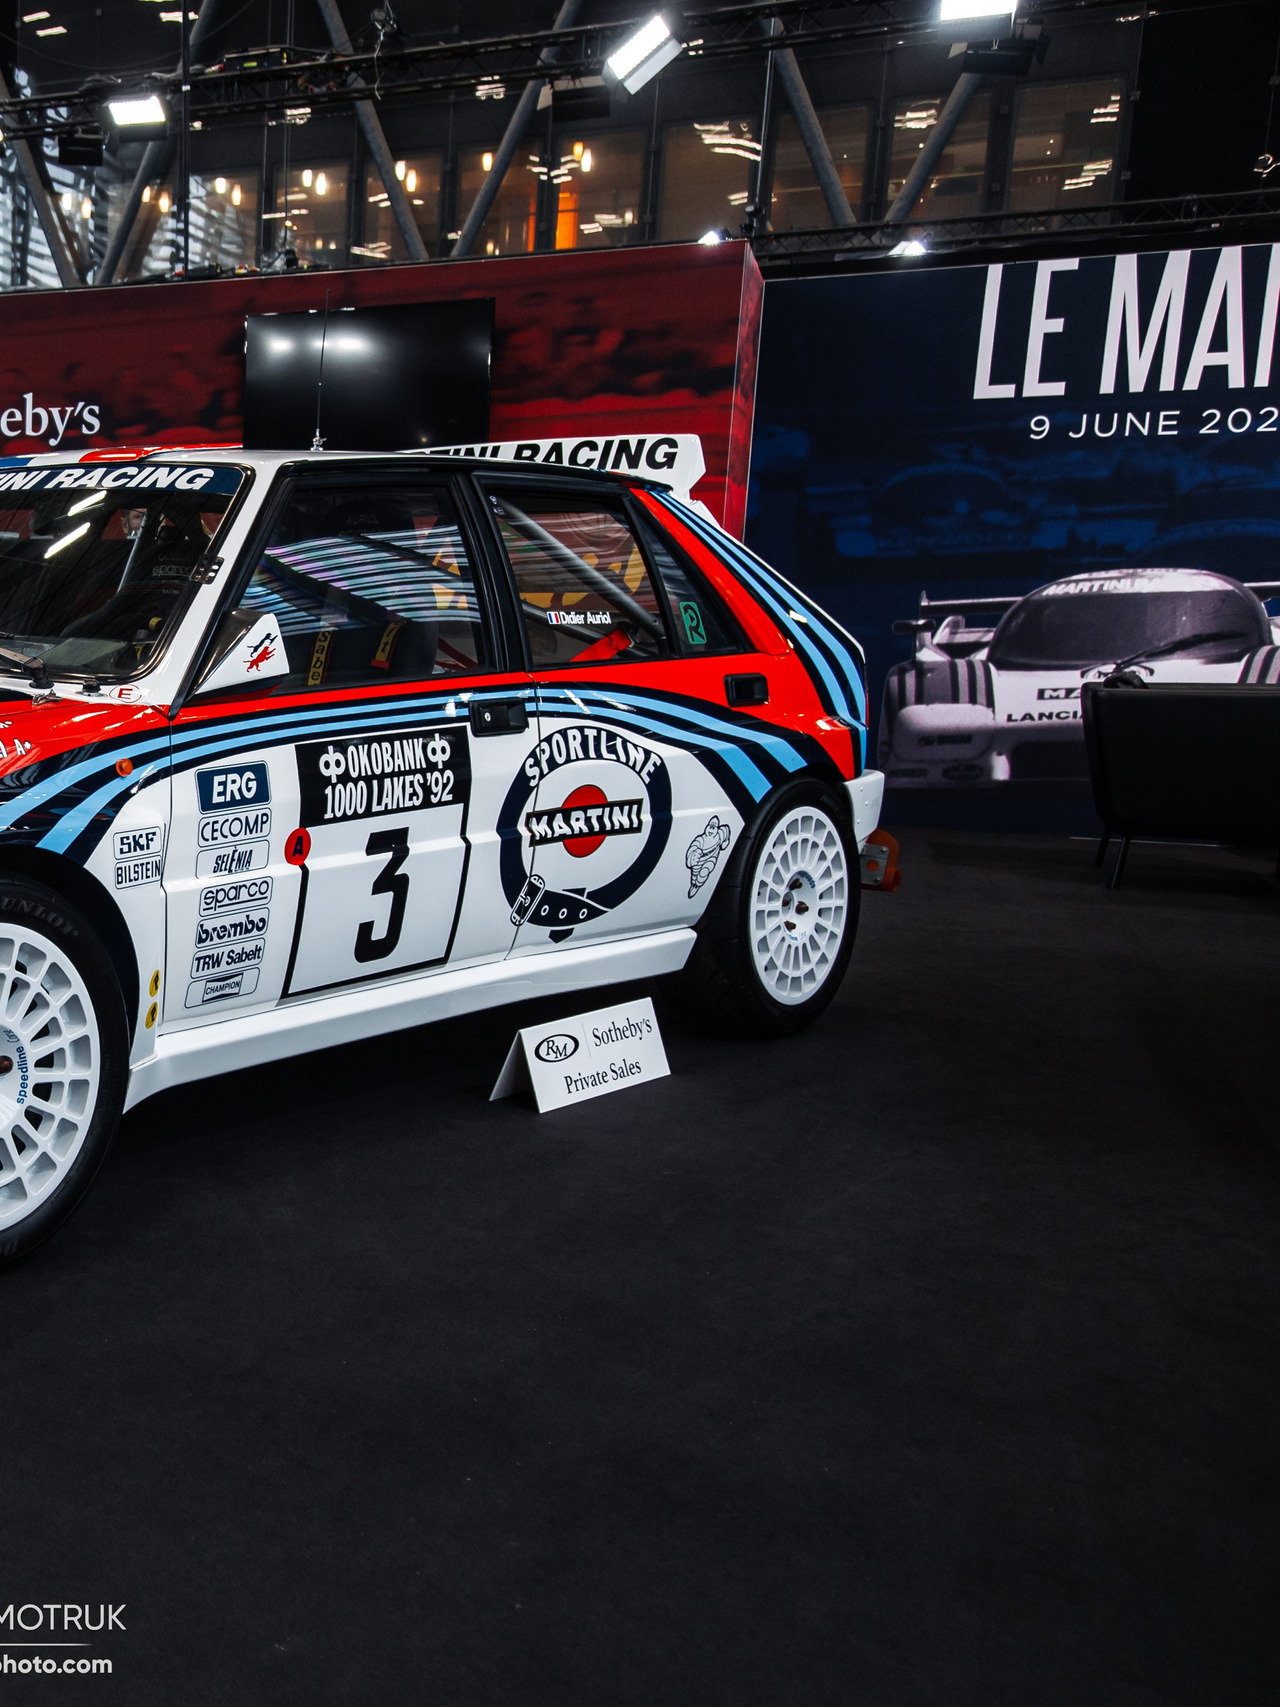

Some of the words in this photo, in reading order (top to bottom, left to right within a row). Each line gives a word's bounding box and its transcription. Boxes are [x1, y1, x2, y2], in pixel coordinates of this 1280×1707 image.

[973, 258, 1080, 400] LE
[1030, 415, 1051, 440] 9
[1069, 410, 1180, 440] JUNE
[513, 438, 678, 470] RACING
[47, 466, 216, 491] RACING
[586, 611, 612, 625] Auriol
[117, 688, 133, 699] E
[525, 728, 662, 787] SPORTLINE
[211, 771, 257, 804] ERG
[324, 780, 368, 819] 1000
[371, 773, 424, 812] LAKES
[200, 812, 270, 842] CECOMP
[530, 804, 639, 841] MARTINI
[120, 831, 157, 855] SKF
[292, 835, 305, 857] A
[116, 859, 161, 887] BILSTEIN
[202, 880, 270, 907] sparco
[353, 826, 411, 964] 3
[197, 914, 267, 944] brembo
[195, 951, 226, 973] TRW
[226, 945, 262, 965] Sabelt
[205, 980, 240, 995] CHAMPION
[592, 1017, 652, 1047] Sotheby's
[16, 1045, 29, 1105] speedline
[564, 1070, 609, 1094] Private
[609, 1058, 642, 1081] Sales
